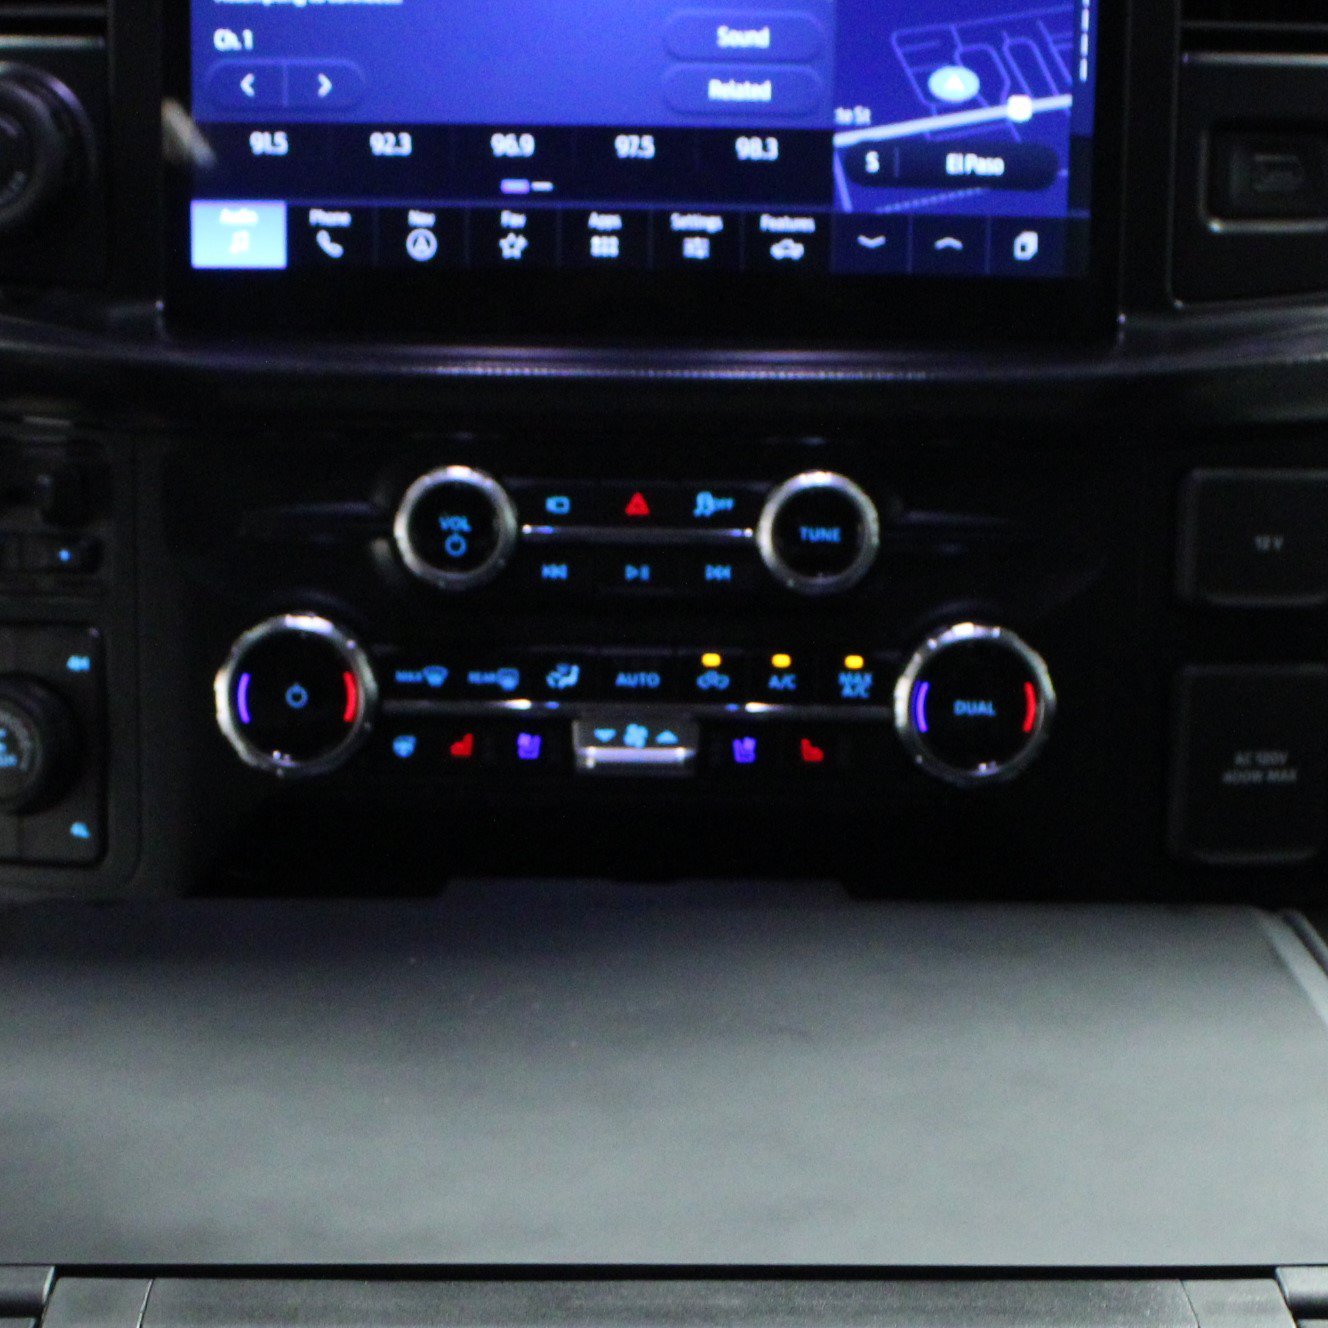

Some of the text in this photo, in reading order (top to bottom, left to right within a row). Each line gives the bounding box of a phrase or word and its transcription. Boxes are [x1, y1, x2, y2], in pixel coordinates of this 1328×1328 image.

[717, 25, 770, 48] Sound
[709, 79, 771, 100] Related
[615, 135, 655, 158] 97.5
[439, 516, 471, 532] VOL
[800, 527, 840, 542] TUNE
[615, 673, 660, 688] AUTO
[769, 675, 796, 690] A/C
[839, 673, 872, 685] MAX
[842, 685, 870, 698] A/C
[954, 701, 995, 716] DUAL
